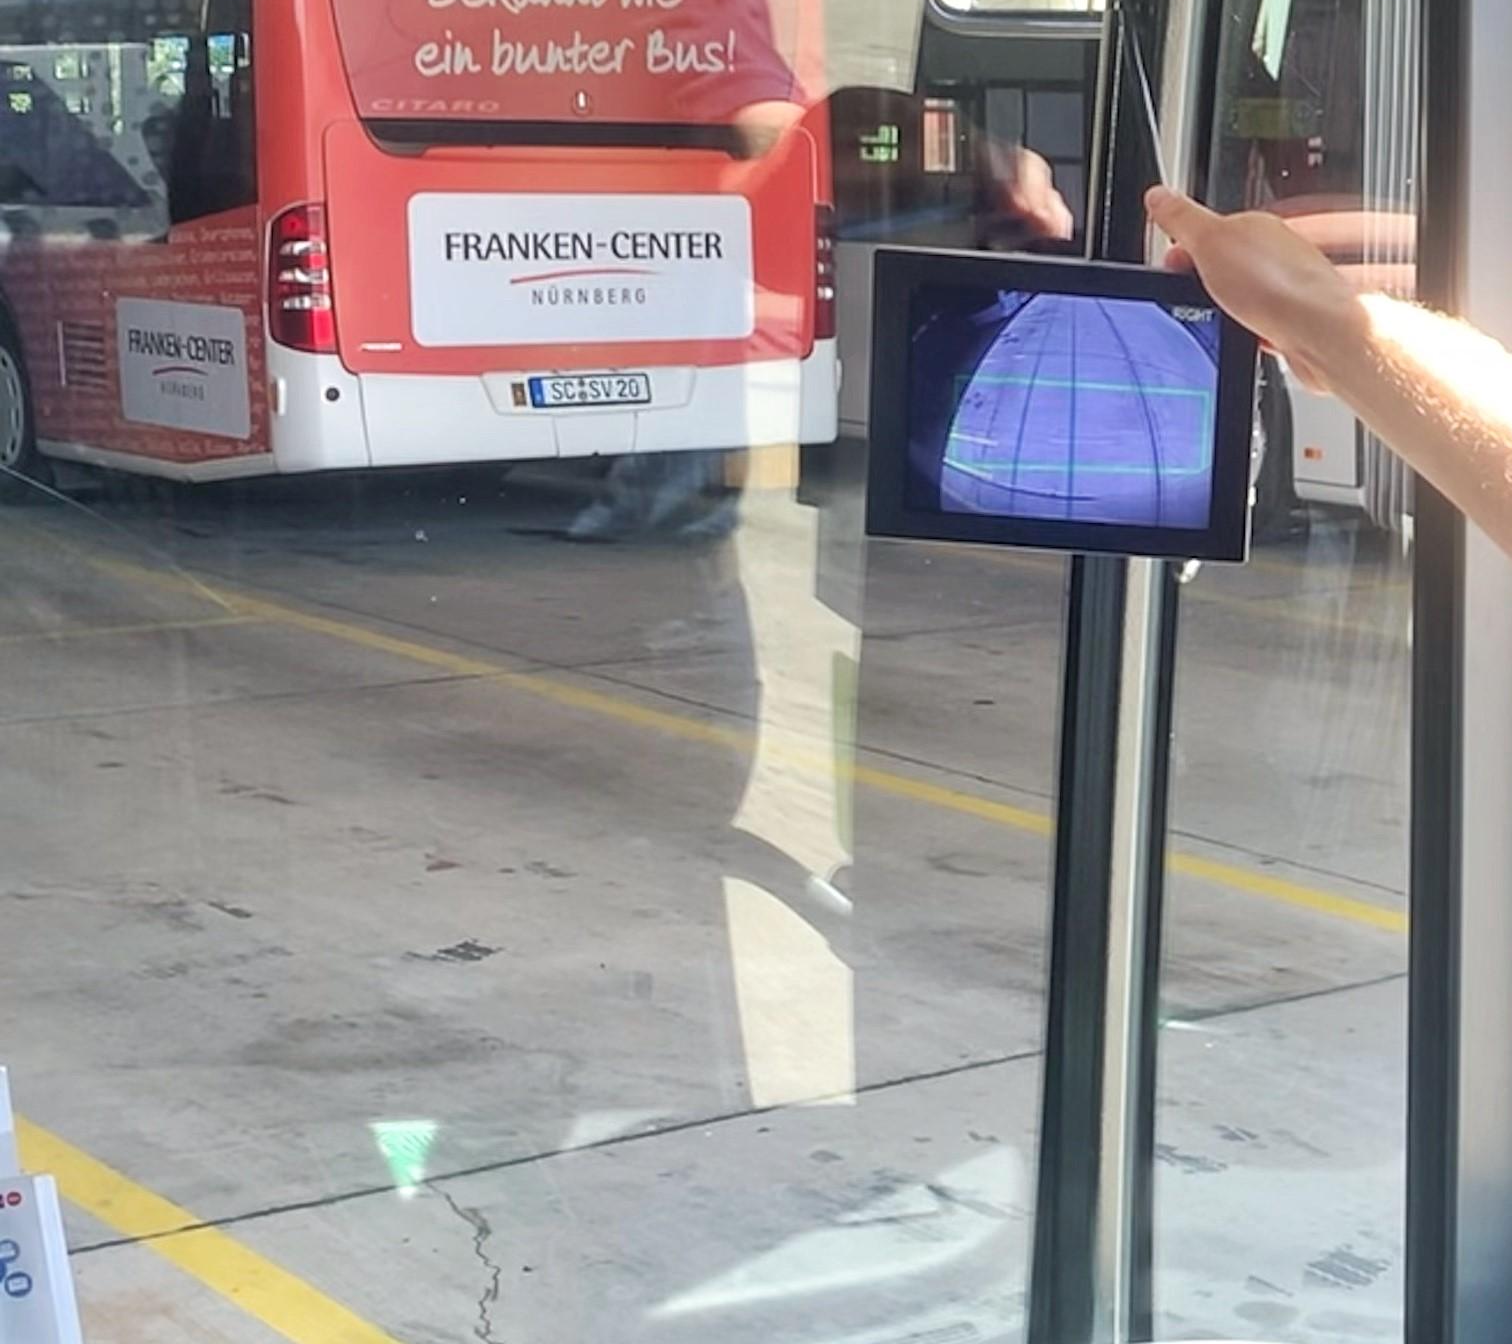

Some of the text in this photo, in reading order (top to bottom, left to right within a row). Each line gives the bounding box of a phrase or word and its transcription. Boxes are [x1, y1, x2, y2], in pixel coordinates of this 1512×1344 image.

[414, 28, 736, 76] ein bunter Bus!
[370, 98, 500, 113] CITARO
[444, 231, 723, 261] FRANKEN-CENTER
[531, 286, 647, 306] NÜRNBERG
[1172, 305, 1215, 323] RIGHT
[127, 328, 235, 366] FRANKEN-CENTER
